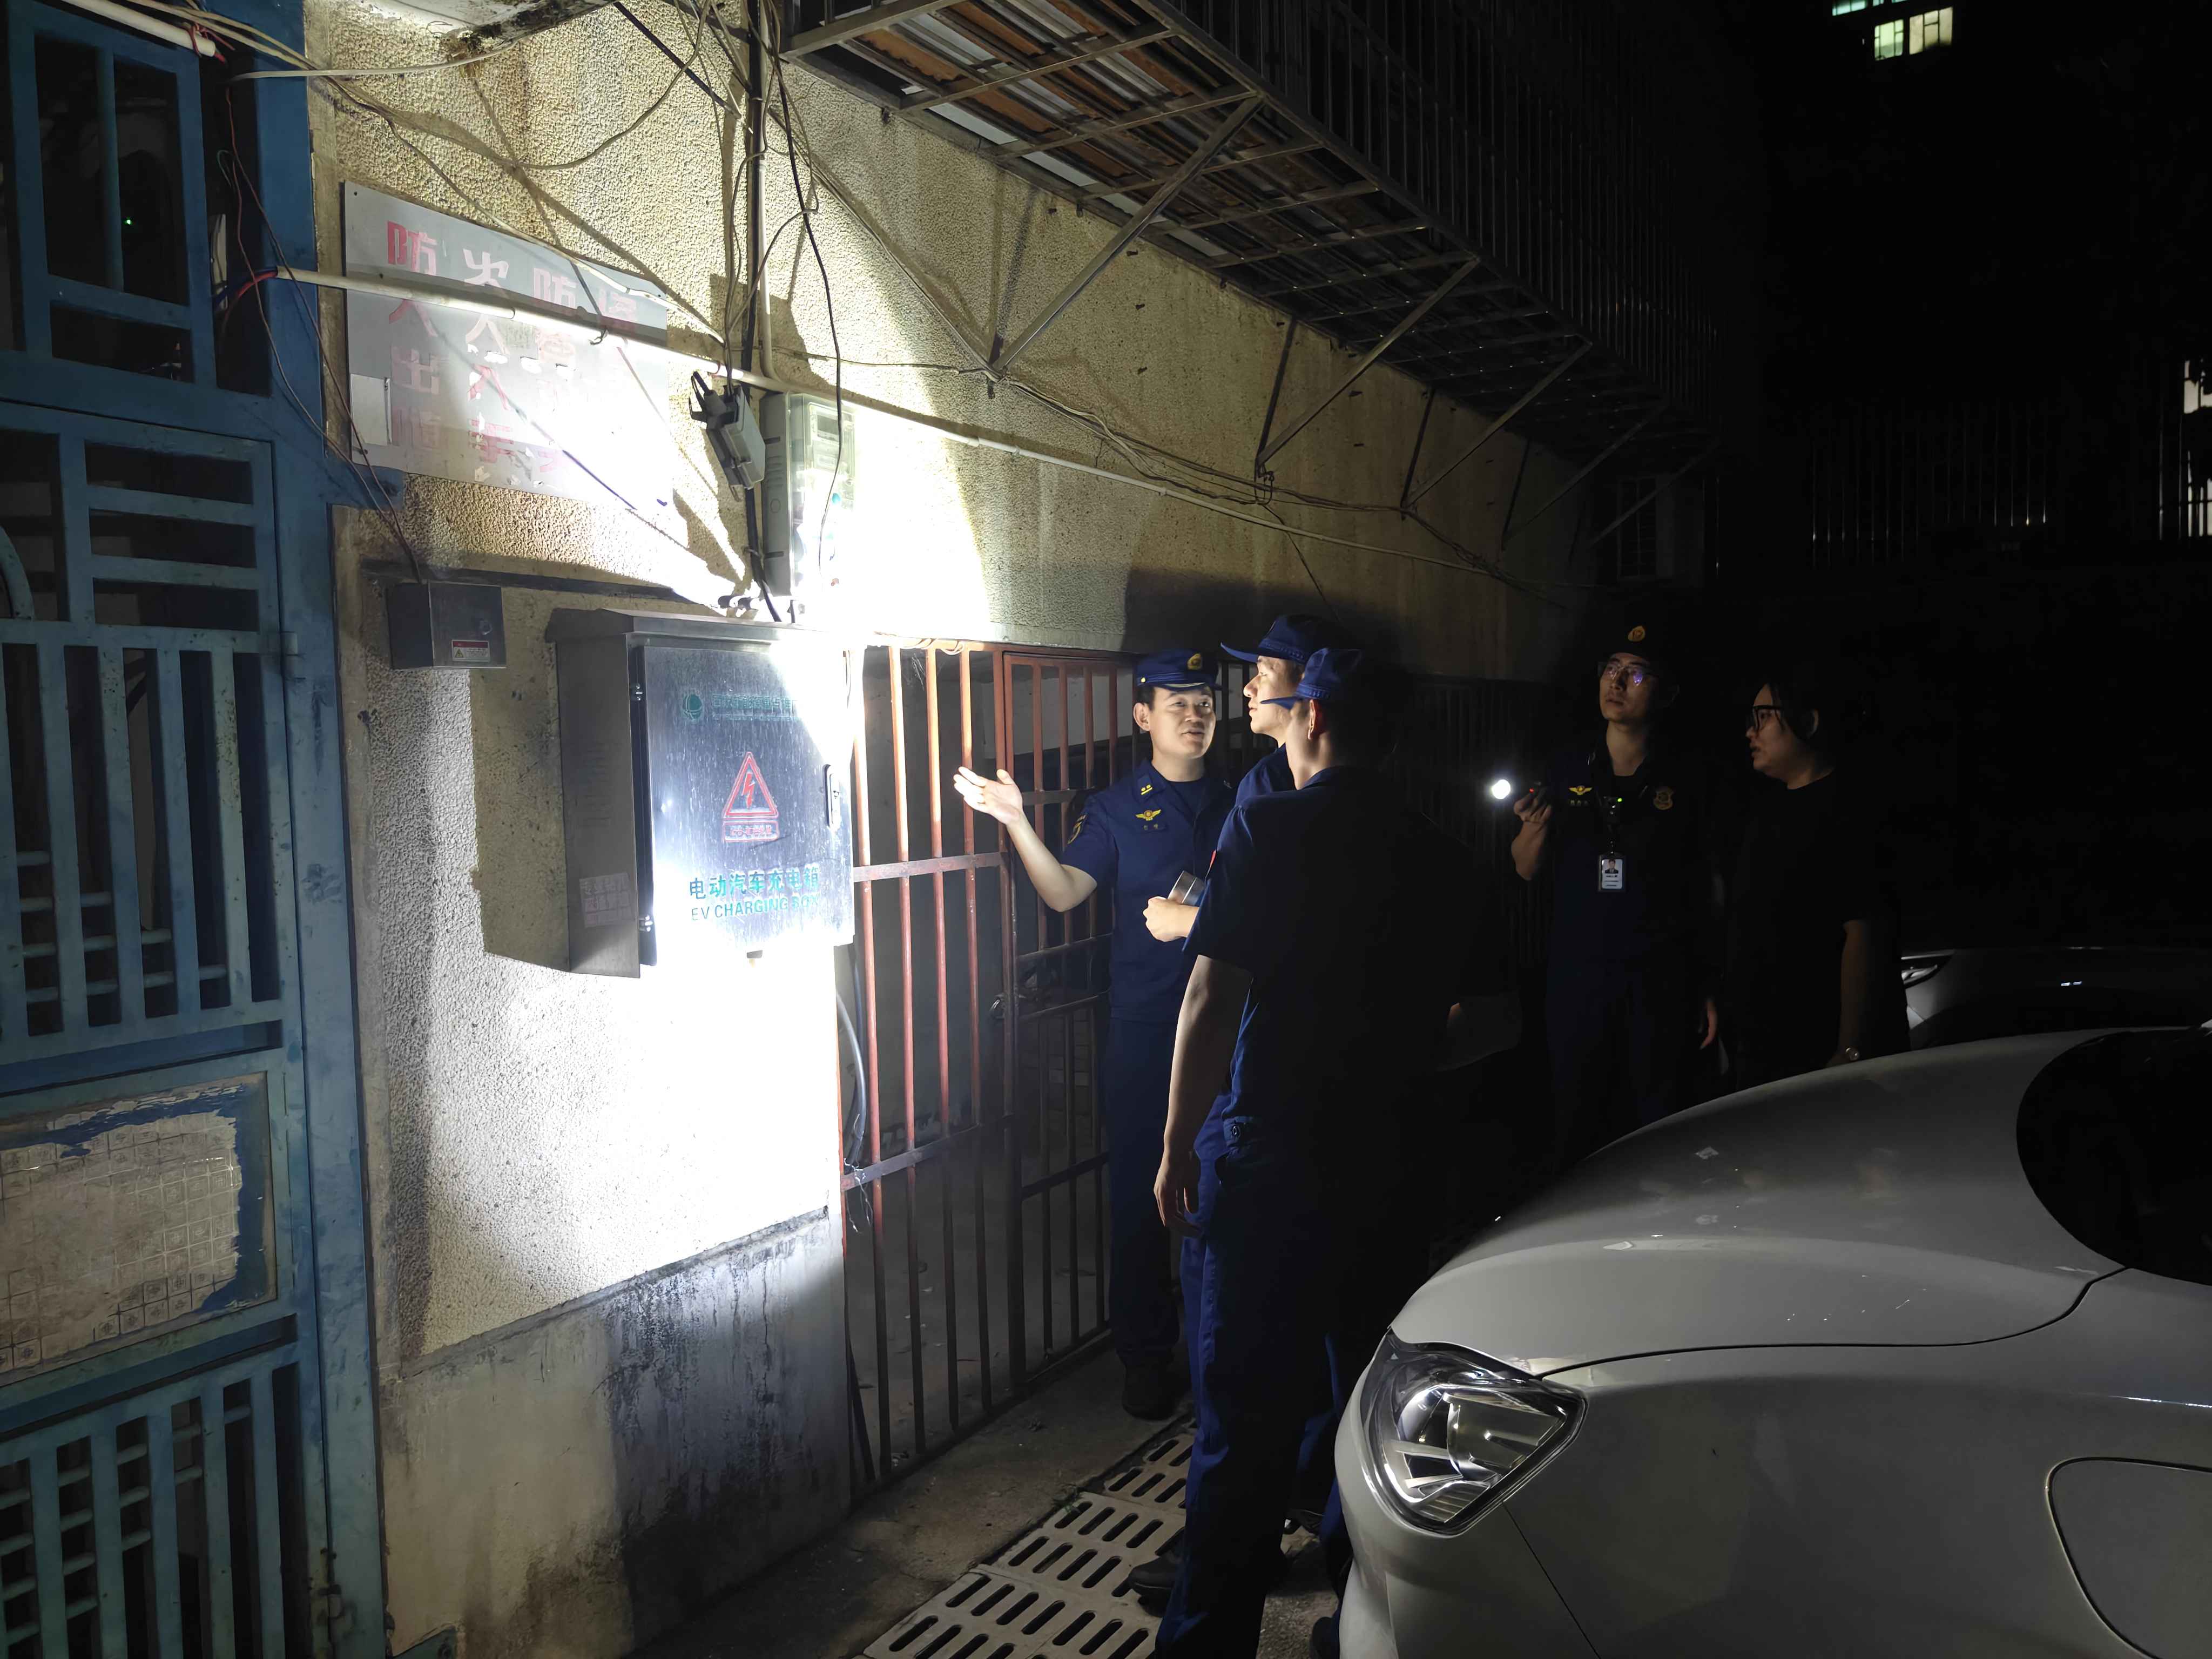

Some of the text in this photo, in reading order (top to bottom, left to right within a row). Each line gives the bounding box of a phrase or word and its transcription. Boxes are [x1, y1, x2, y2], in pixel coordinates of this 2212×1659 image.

[689, 866, 820, 899] 电动汽车充电箱
[692, 894, 820, 921] EV CHARGING BOX
